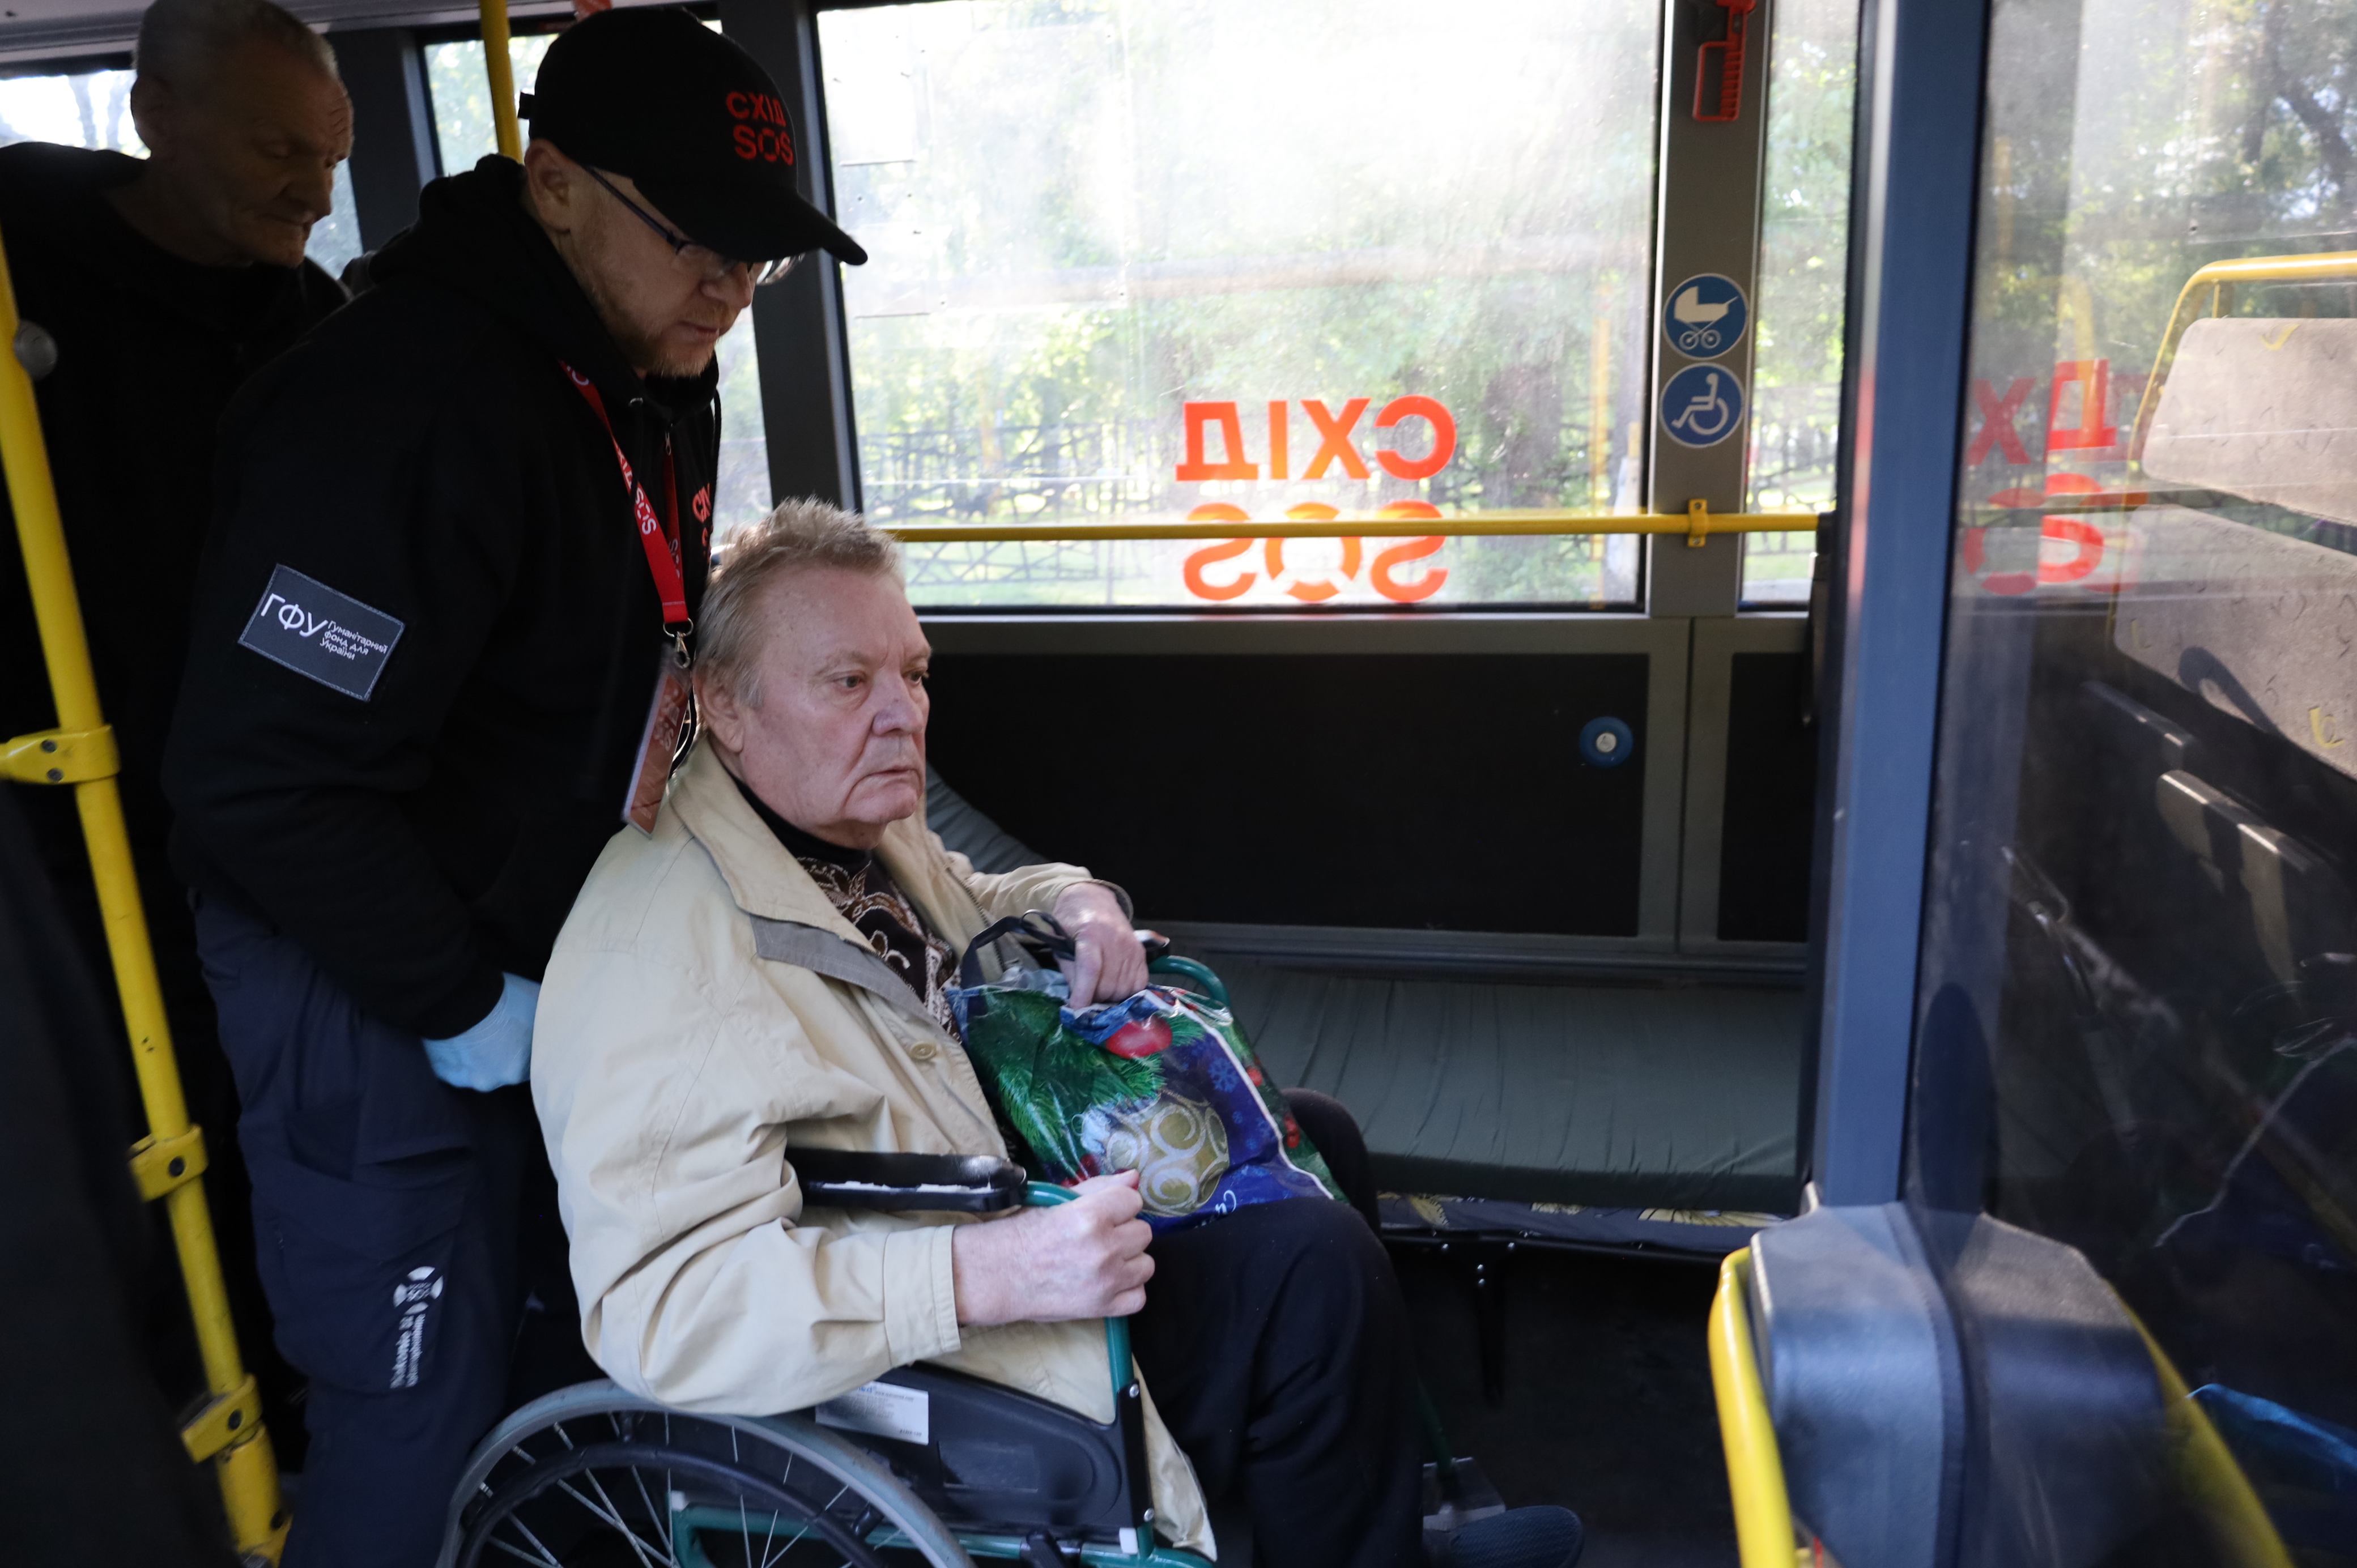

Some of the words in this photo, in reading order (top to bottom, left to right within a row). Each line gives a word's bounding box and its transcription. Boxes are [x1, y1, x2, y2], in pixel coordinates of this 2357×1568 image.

[726, 91, 786, 127] СХІД
[733, 124, 794, 166] SOS
[635, 487, 657, 535] SOS
[260, 593, 329, 637] ГФУ
[320, 637, 356, 661] України
[324, 630, 348, 647] фонд
[349, 642, 369, 655] для
[327, 620, 389, 654] Гуманітарний
